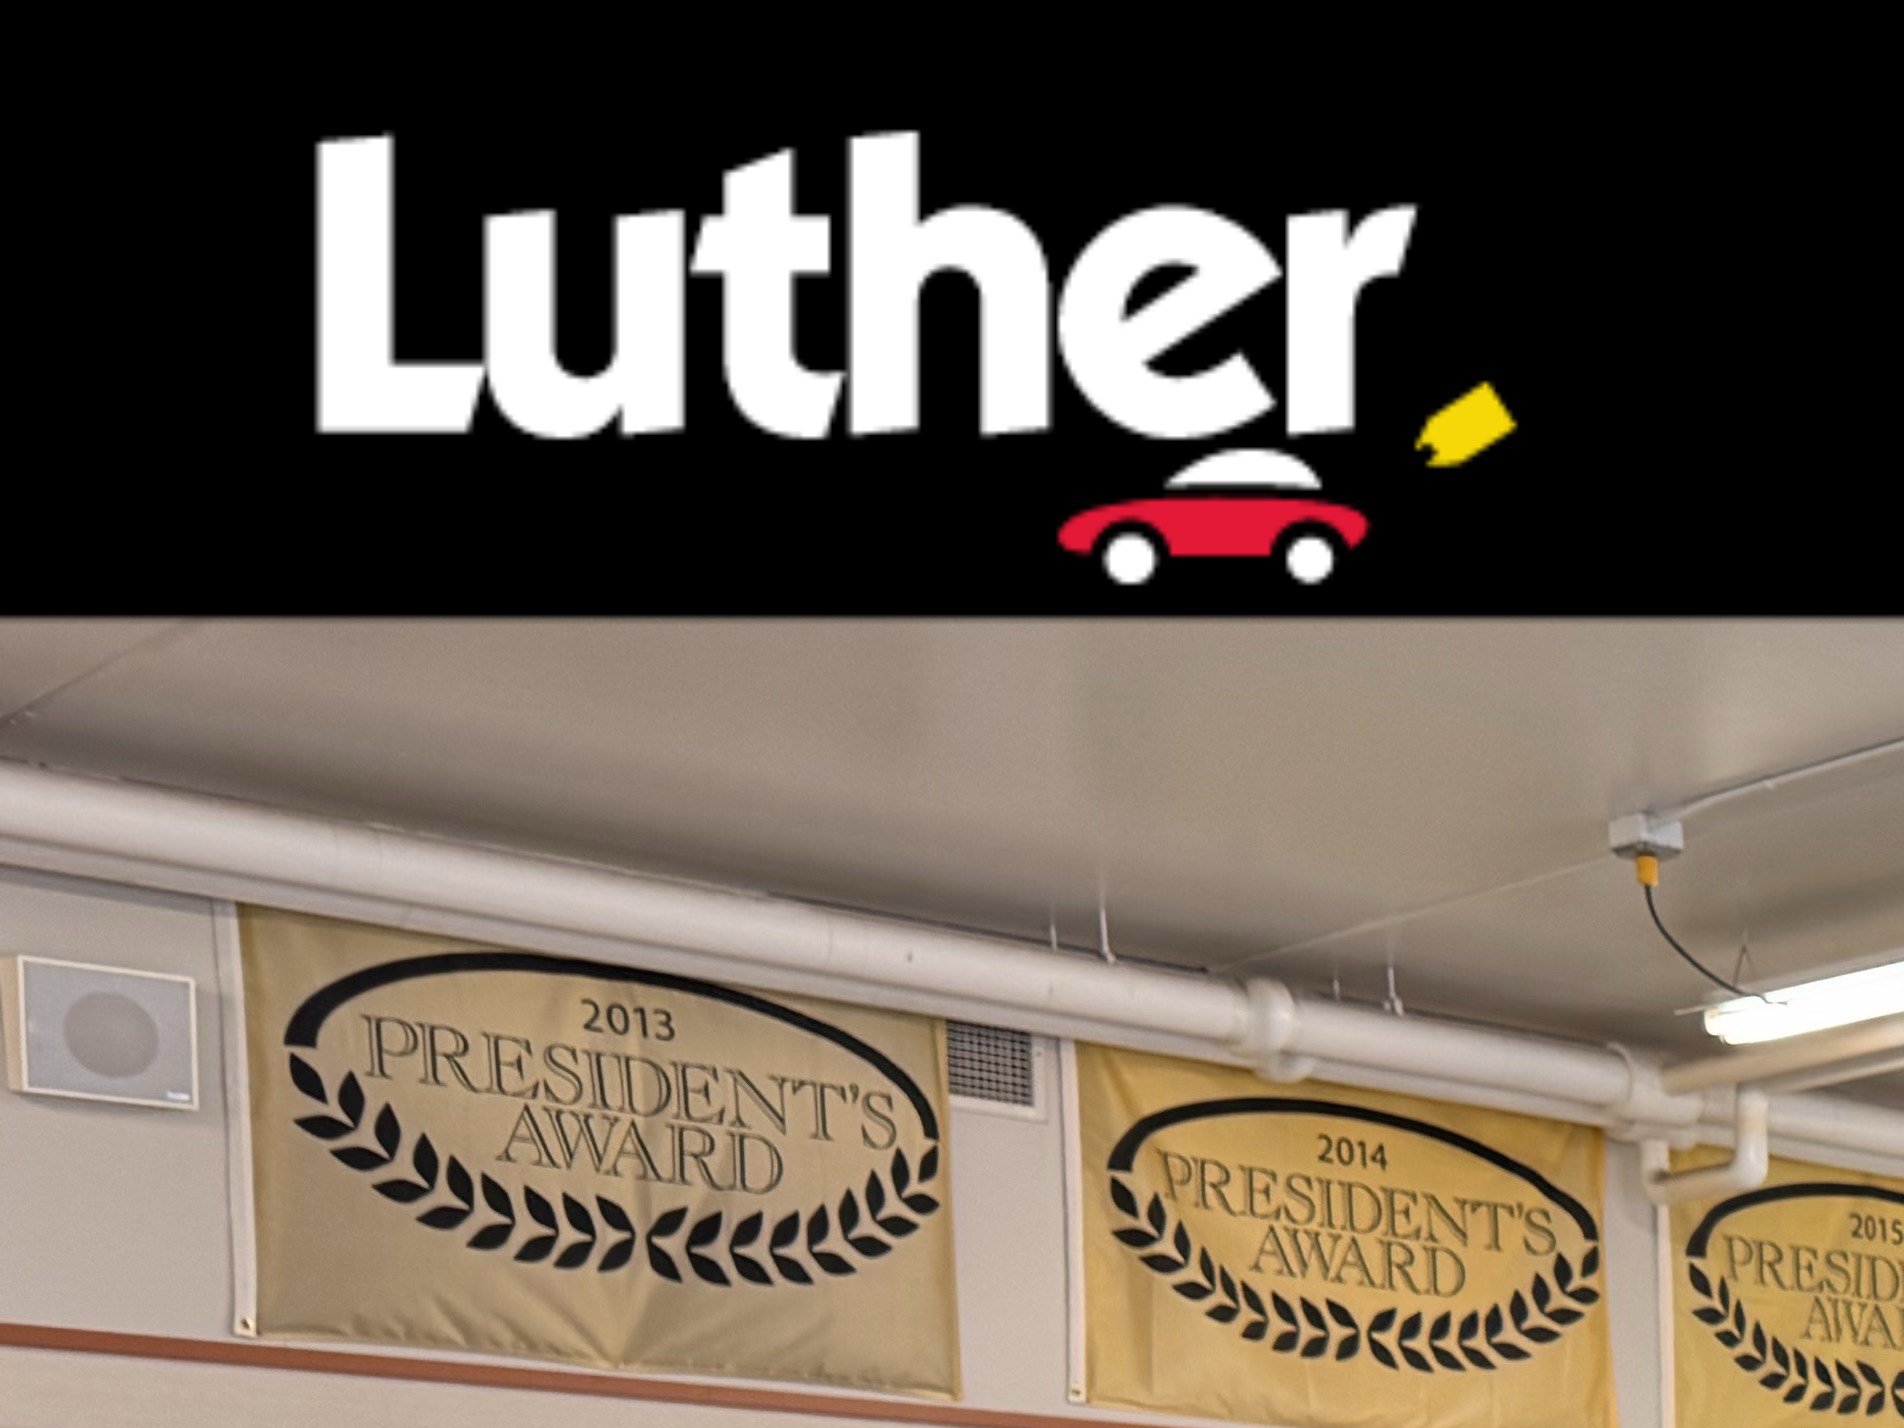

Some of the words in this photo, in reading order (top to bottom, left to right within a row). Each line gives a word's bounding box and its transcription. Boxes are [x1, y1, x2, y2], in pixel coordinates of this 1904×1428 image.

[581, 998, 677, 1042] 2013
[361, 1013, 897, 1151] PRESIDENT'S
[494, 1102, 785, 1195] AWARD
[1316, 1133, 1389, 1171] 2014
[1157, 1148, 1559, 1258] PRESIDENT'S
[1847, 1211, 1904, 1245] 2015
[1249, 1223, 1467, 1298] AWARD
